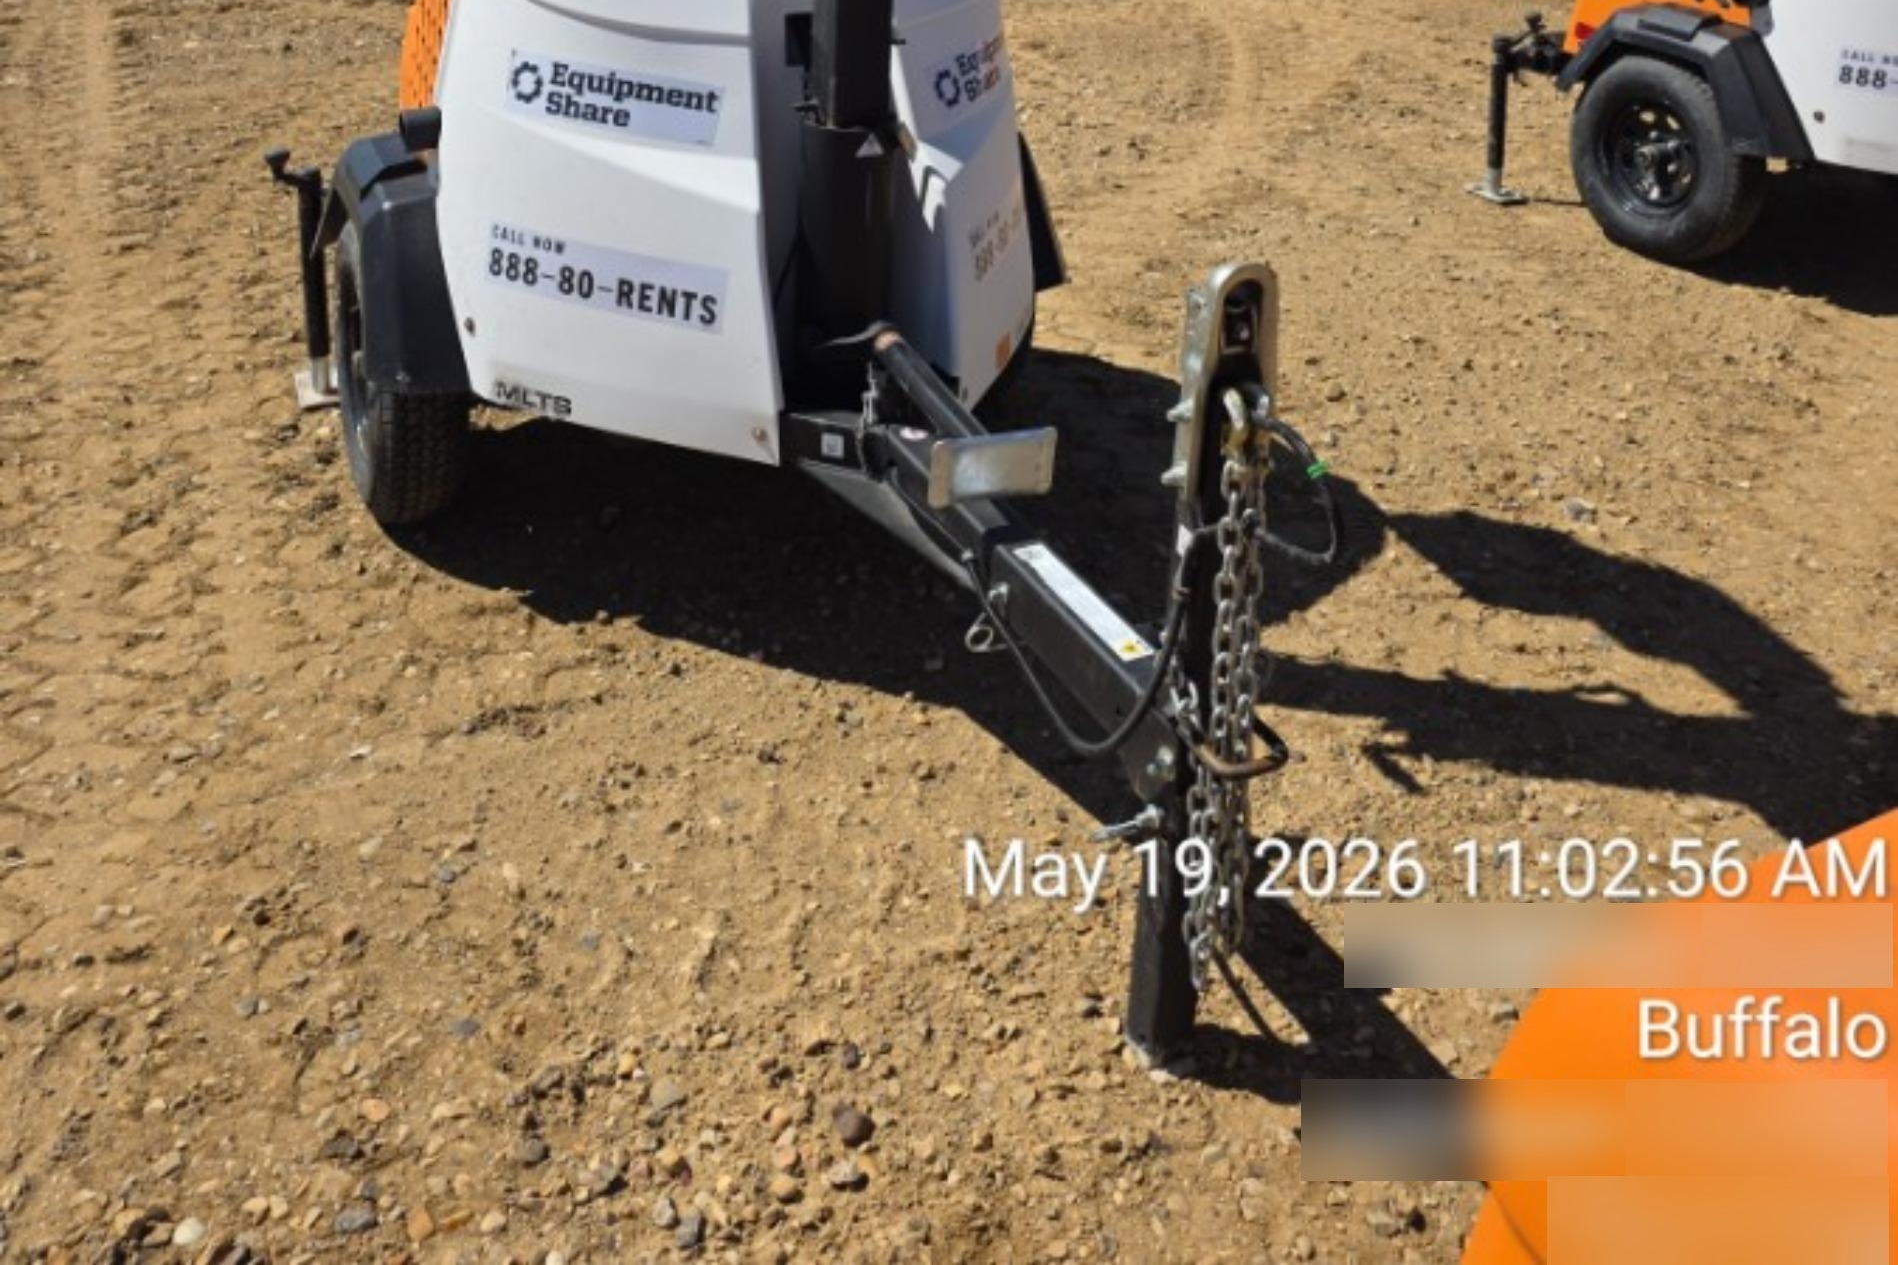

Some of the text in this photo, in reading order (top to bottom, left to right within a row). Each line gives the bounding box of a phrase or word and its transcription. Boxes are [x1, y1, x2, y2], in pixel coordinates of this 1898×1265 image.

[549, 61, 719, 113] Equipment
[545, 92, 631, 127] Share
[493, 224, 566, 255] CALL NOW
[489, 247, 718, 326] 888-80-RENTS
